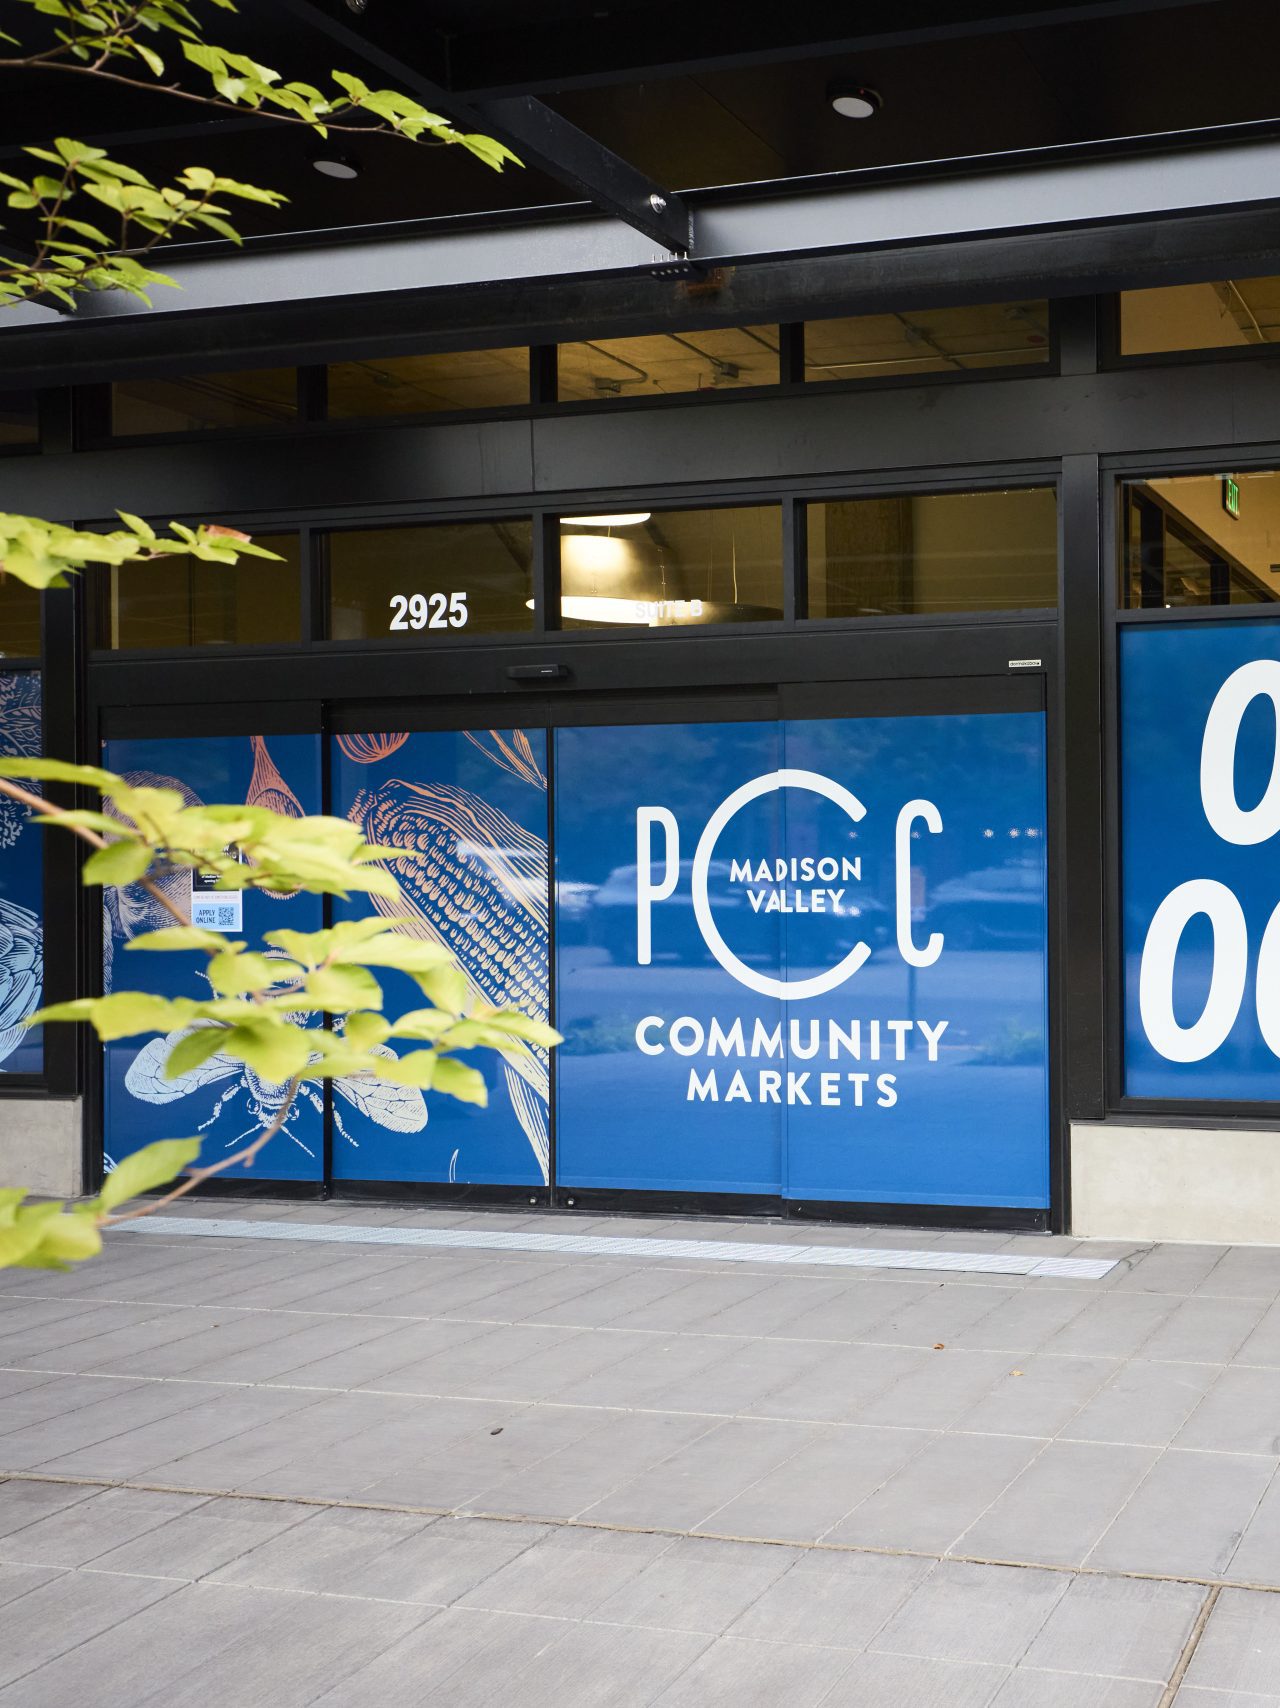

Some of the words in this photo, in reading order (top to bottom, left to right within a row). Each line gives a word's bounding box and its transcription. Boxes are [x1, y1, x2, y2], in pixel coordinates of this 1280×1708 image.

[389, 592, 468, 630] 2925
[636, 769, 945, 1000] PCC
[729, 857, 861, 882] MADISON
[199, 909, 216, 917] APPLY
[746, 889, 846, 913] VALLEY
[196, 916, 216, 924] ONLINE
[635, 1016, 949, 1061] COMMUNITY
[686, 1067, 898, 1108] MARKETS
